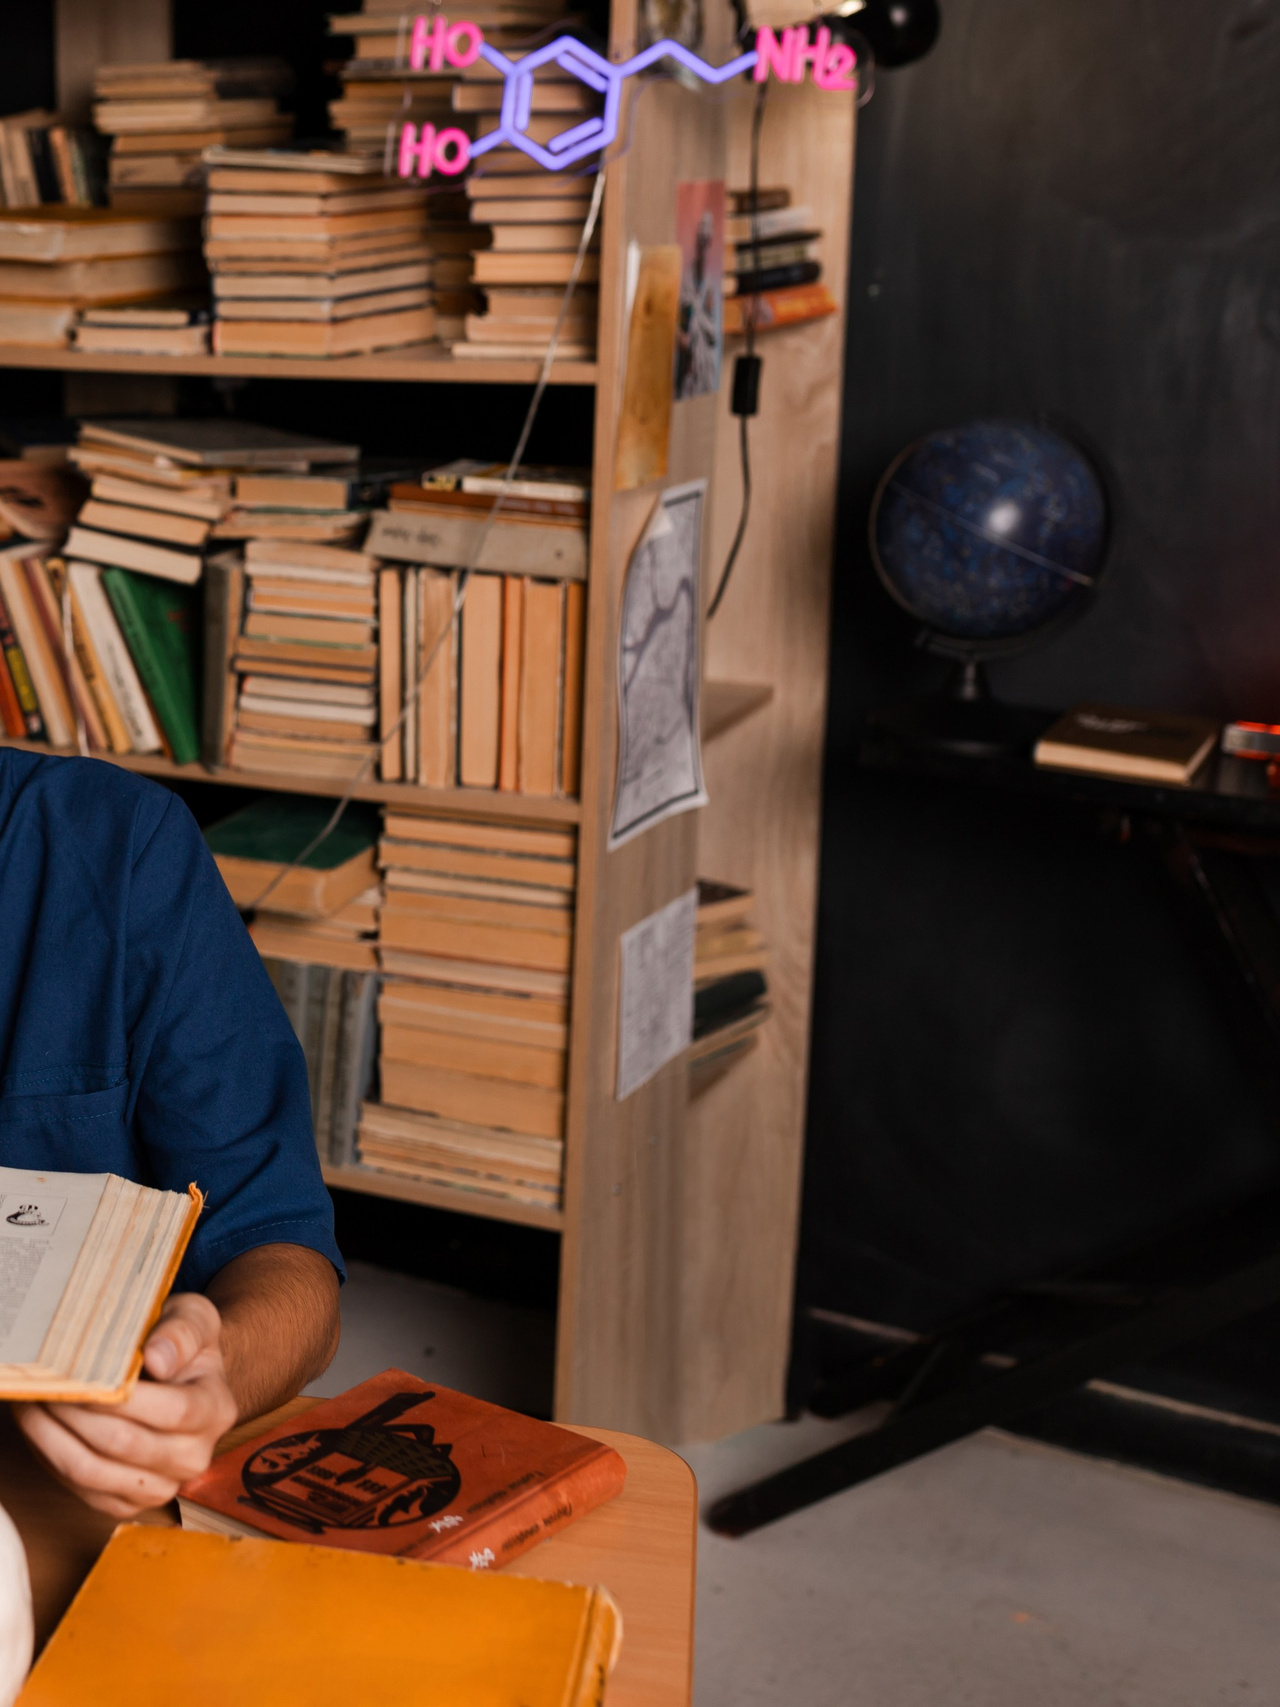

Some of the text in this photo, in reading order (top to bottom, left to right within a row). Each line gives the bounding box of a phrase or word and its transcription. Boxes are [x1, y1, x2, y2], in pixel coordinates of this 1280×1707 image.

[409, 14, 485, 72] HO
[753, 24, 857, 91] NH2
[398, 121, 471, 178] HO
